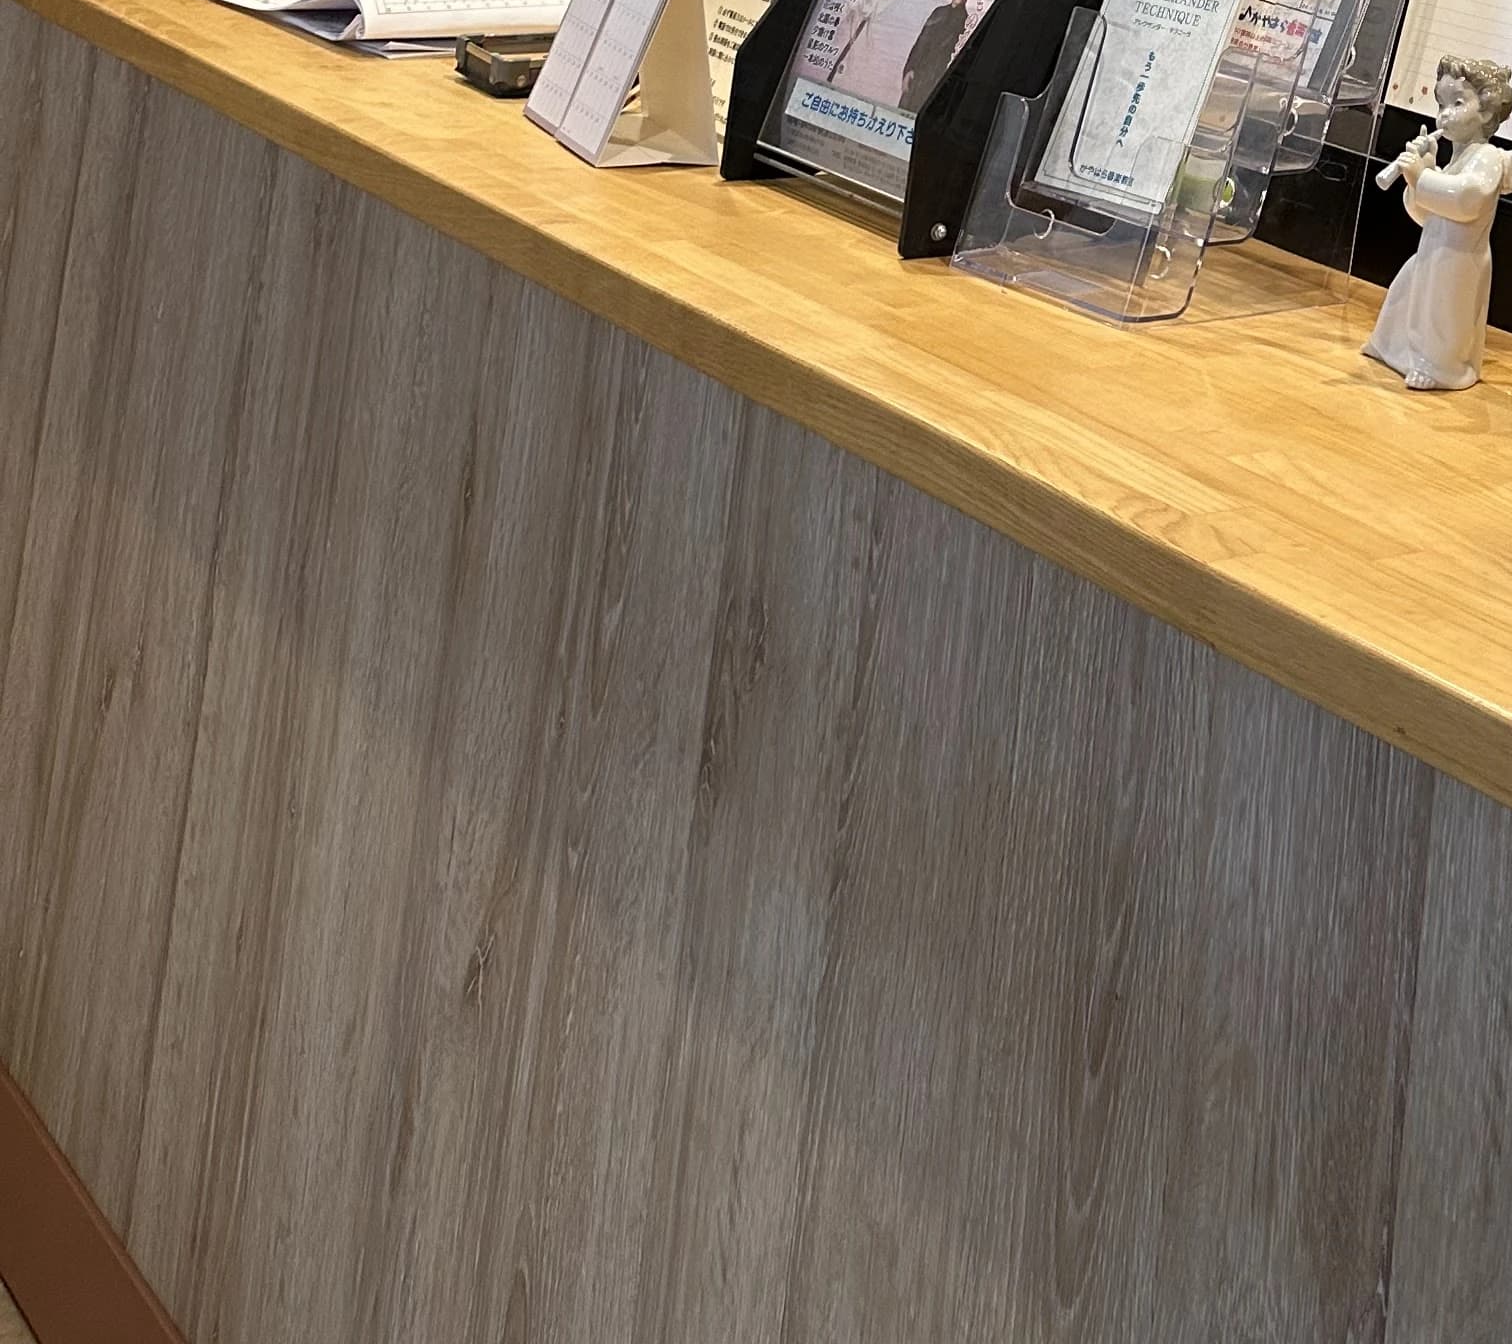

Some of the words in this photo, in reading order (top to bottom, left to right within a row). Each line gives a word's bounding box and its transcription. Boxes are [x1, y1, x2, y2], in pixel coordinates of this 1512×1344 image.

[1135, 1, 1202, 27] TECHNIQUE
[1115, 50, 1156, 148] もう一歩先の自分へ
